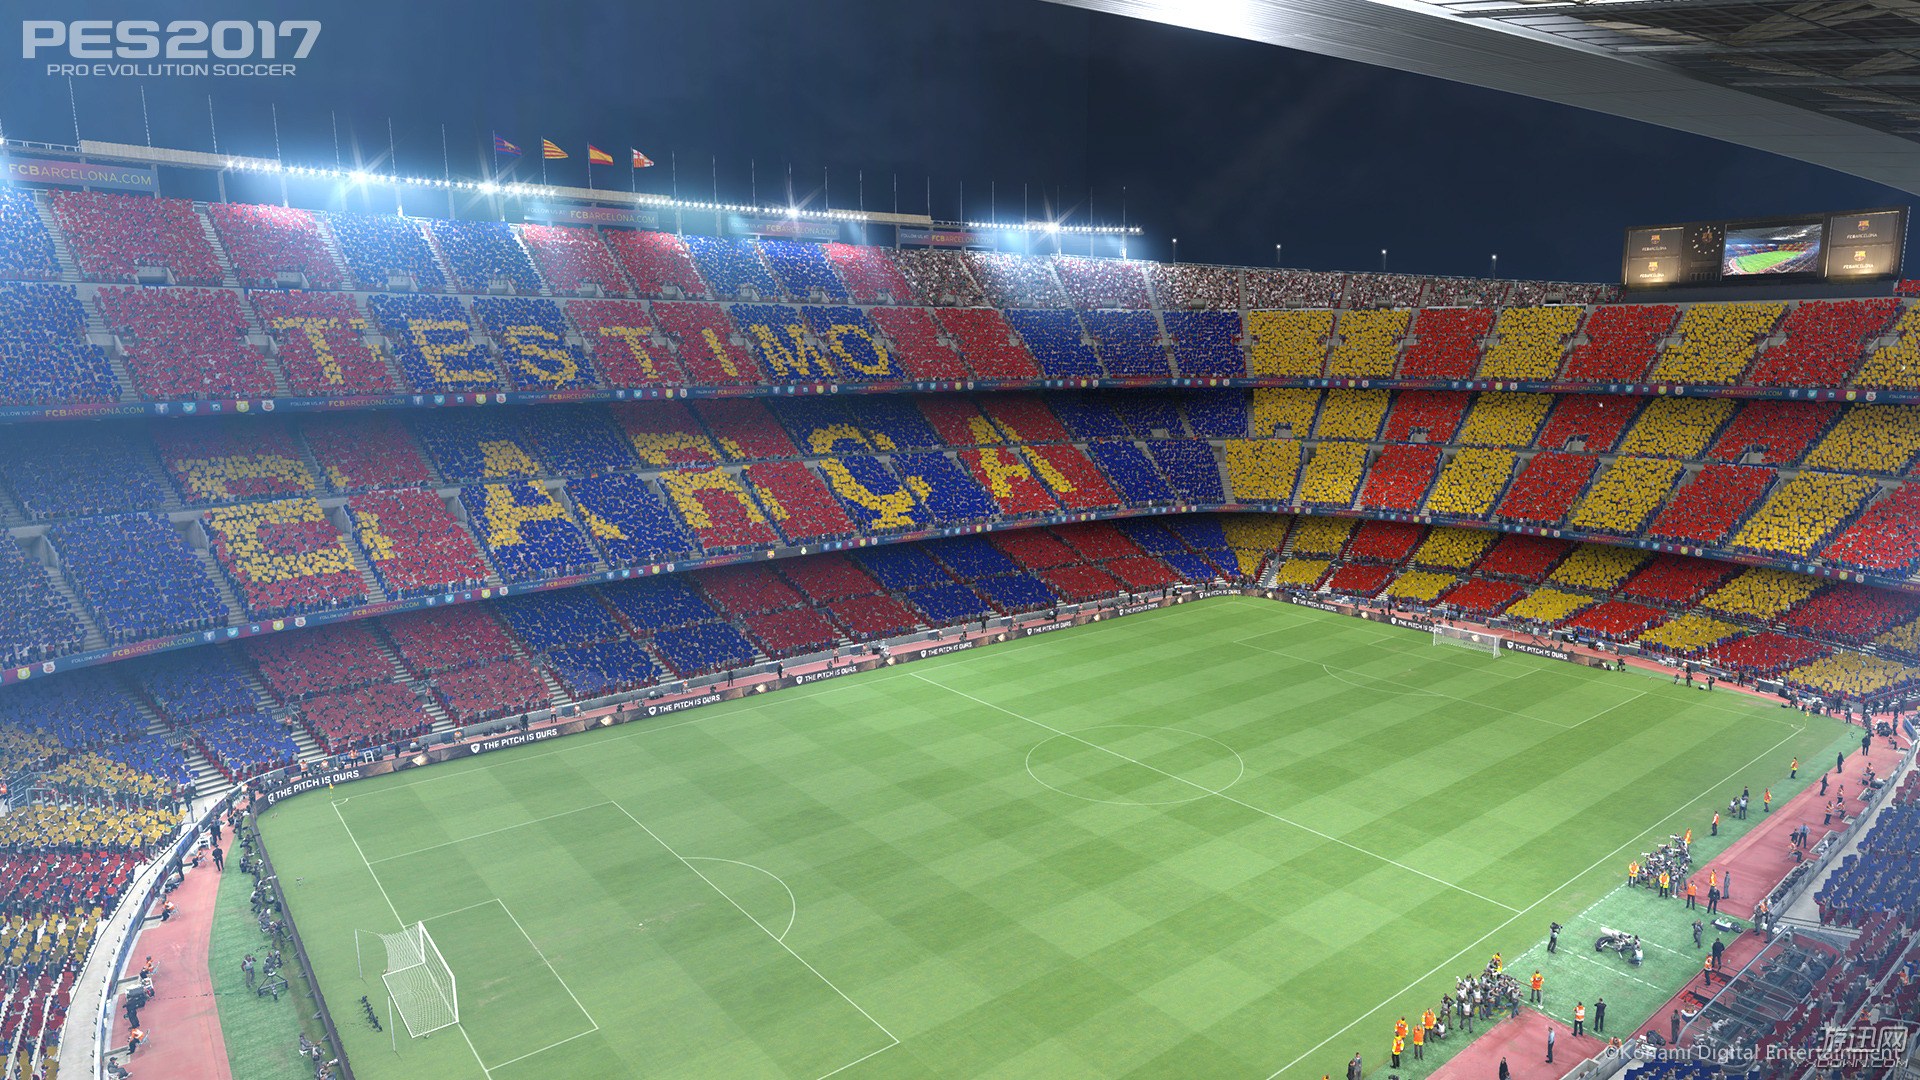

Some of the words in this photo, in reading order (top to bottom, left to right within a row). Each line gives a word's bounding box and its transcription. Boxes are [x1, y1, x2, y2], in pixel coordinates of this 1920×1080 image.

[9, 163, 152, 185] FCBARCELONA.COM
[570, 210, 655, 224] FCBARCELONA.COM
[766, 223, 837, 235] FCBARCELONA.COM
[328, 398, 405, 407] FCBARCELONA.COM
[45, 407, 145, 417] FCBARCELONA.COM
[352, 602, 419, 617] FCBARCELONA.COM
[112, 637, 195, 658] FCBARCELONA.COM
[1527, 646, 1543, 656] PITCH
[1551, 651, 1568, 660] OURS
[817, 671, 834, 679] PITCH
[659, 704, 672, 713] THE
[673, 700, 694, 711] PITCH
[702, 694, 721, 704] OURS
[483, 741, 499, 751] THE
[501, 736, 525, 747] PITCH
[536, 728, 558, 739] OURS
[275, 786, 292, 799] THE
[293, 779, 320, 793] PITCH
[321, 776, 332, 784] IS
[333, 770, 360, 782] OURS
